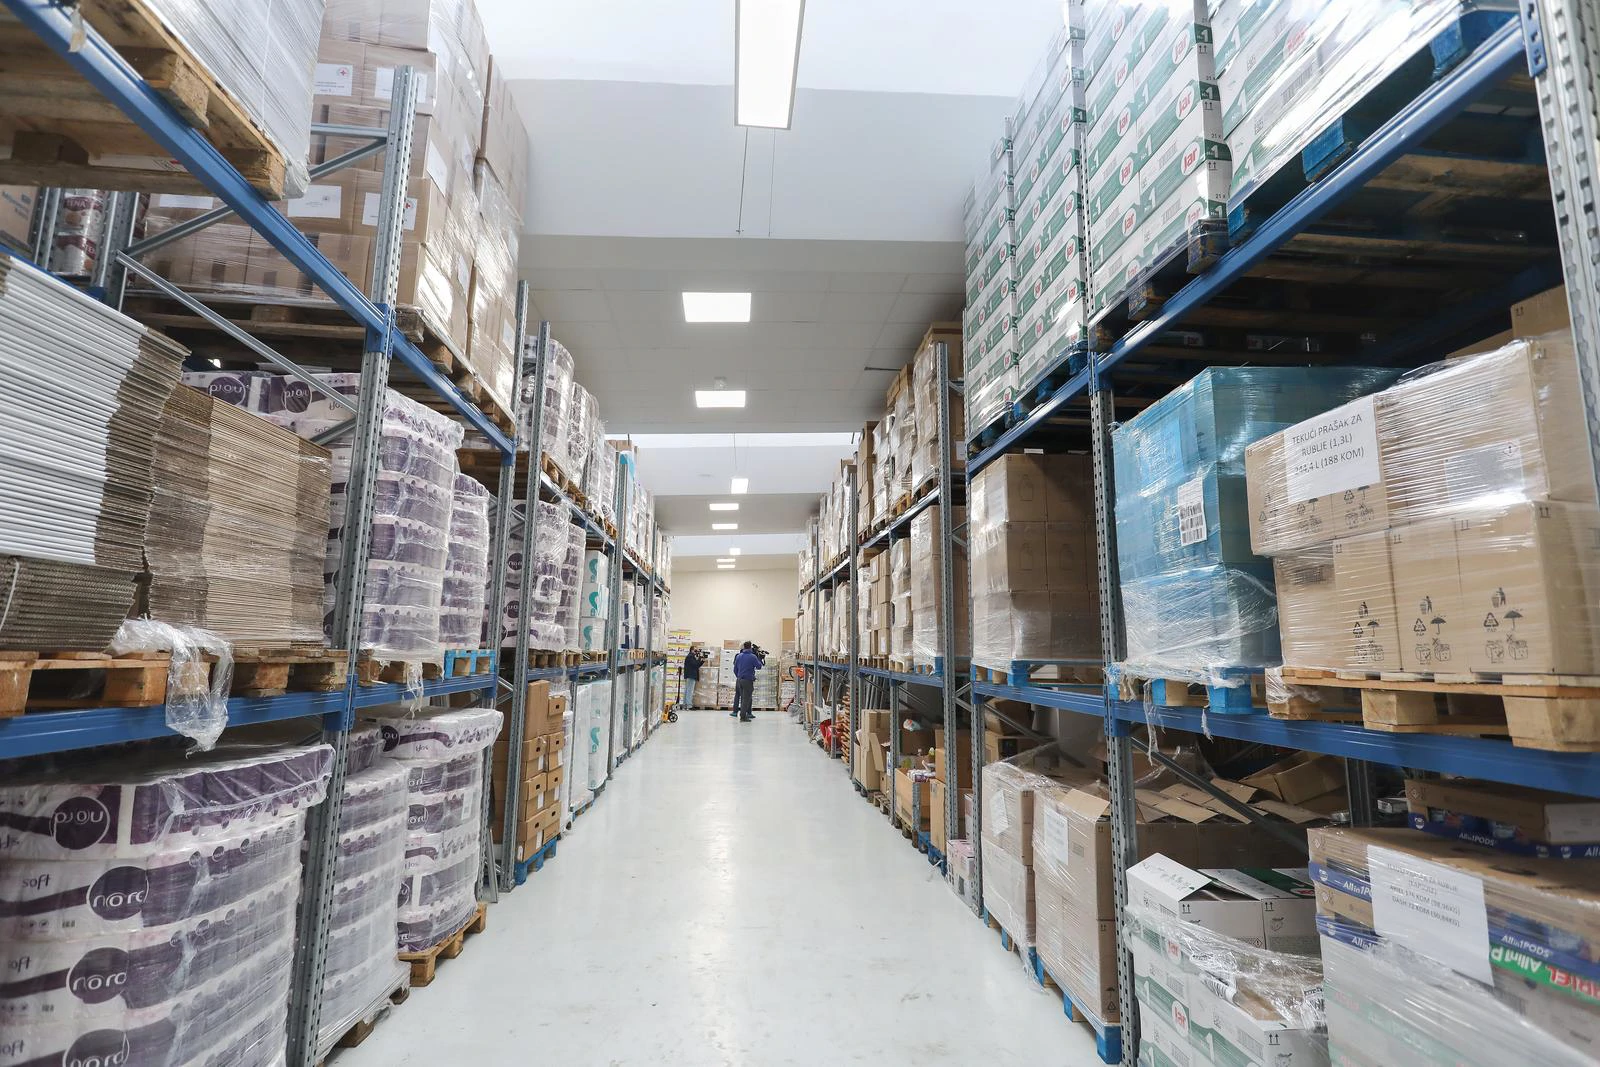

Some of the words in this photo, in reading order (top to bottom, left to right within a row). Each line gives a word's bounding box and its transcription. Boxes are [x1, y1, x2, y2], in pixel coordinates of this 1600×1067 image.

[1178, 92, 1192, 118] Jar
[1184, 148, 1198, 172] Jar
[1121, 164, 1131, 185] Jar
[1124, 214, 1134, 232] Jar
[1292, 428, 1316, 444] TEKUĆI
[1318, 419, 1349, 436] PRAŠAK
[1351, 414, 1363, 425] ZA
[1302, 443, 1327, 456] RUBLJE
[1329, 433, 1353, 449] (1,3L)
[1321, 454, 1338, 469] (188
[1340, 446, 1364, 461] KOM)
[1584, 847, 1600, 857] All
[22, 874, 50, 890] soft
